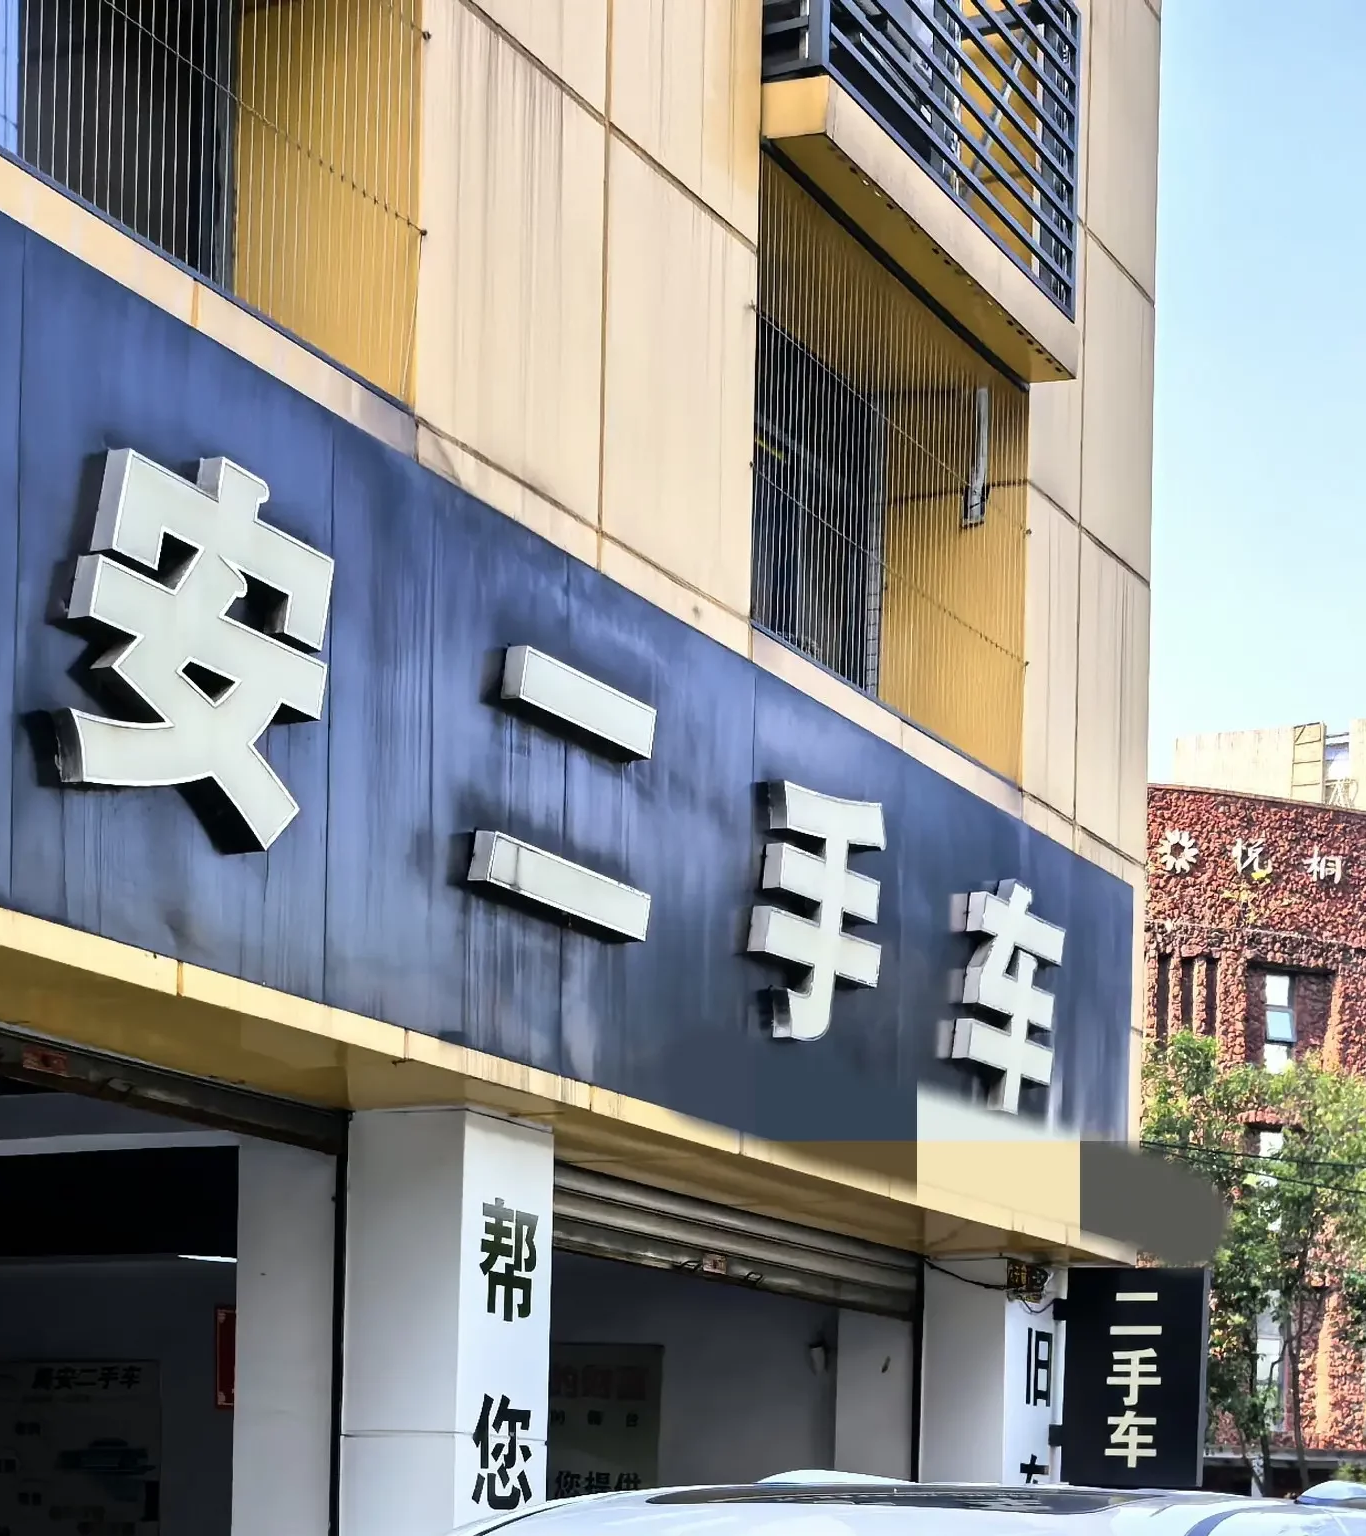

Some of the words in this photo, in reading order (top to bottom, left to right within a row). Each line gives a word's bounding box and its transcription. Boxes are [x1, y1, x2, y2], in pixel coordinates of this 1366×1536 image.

[471, 1197, 540, 1510] 帮您
[1104, 1292, 1162, 1468] 二手车
